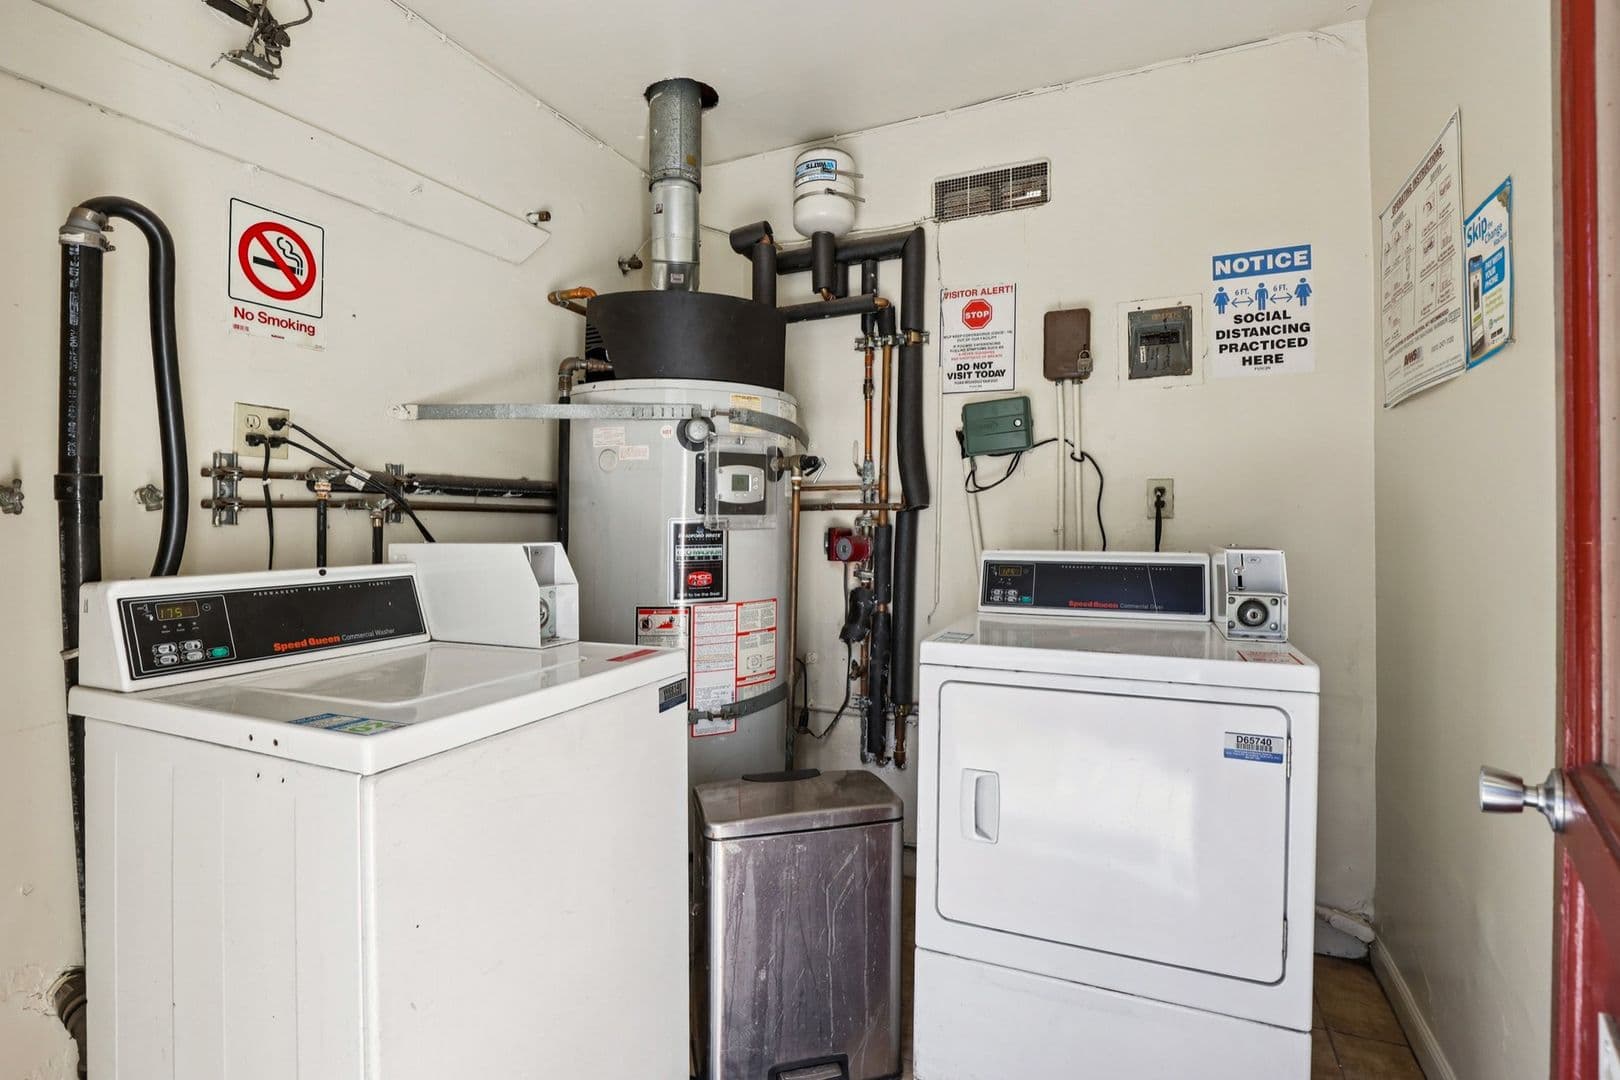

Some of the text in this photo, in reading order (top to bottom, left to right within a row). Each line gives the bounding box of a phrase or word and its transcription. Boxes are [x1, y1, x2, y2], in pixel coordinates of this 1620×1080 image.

[805, 161, 826, 170] WATTS
[1467, 216, 1488, 248] Skip
[1215, 250, 1308, 276] NOTICE
[943, 285, 1013, 300] VISITOR ALERT!
[234, 306, 254, 321] No
[257, 311, 316, 336] Smoking
[965, 310, 989, 320] STOP
[1233, 310, 1291, 324] SOCIAL
[1216, 322, 1311, 340] DISTANCING
[1218, 337, 1308, 354] PRACTICED
[956, 361, 993, 371] DO NOT
[1241, 353, 1284, 366] HERE
[947, 369, 1006, 381] VISIT TODAY
[1068, 600, 1093, 609] Speed
[1093, 601, 1118, 609] Queen
[273, 628, 395, 652] Speed Queen Commercial Washer
[1236, 735, 1272, 746] D65740
